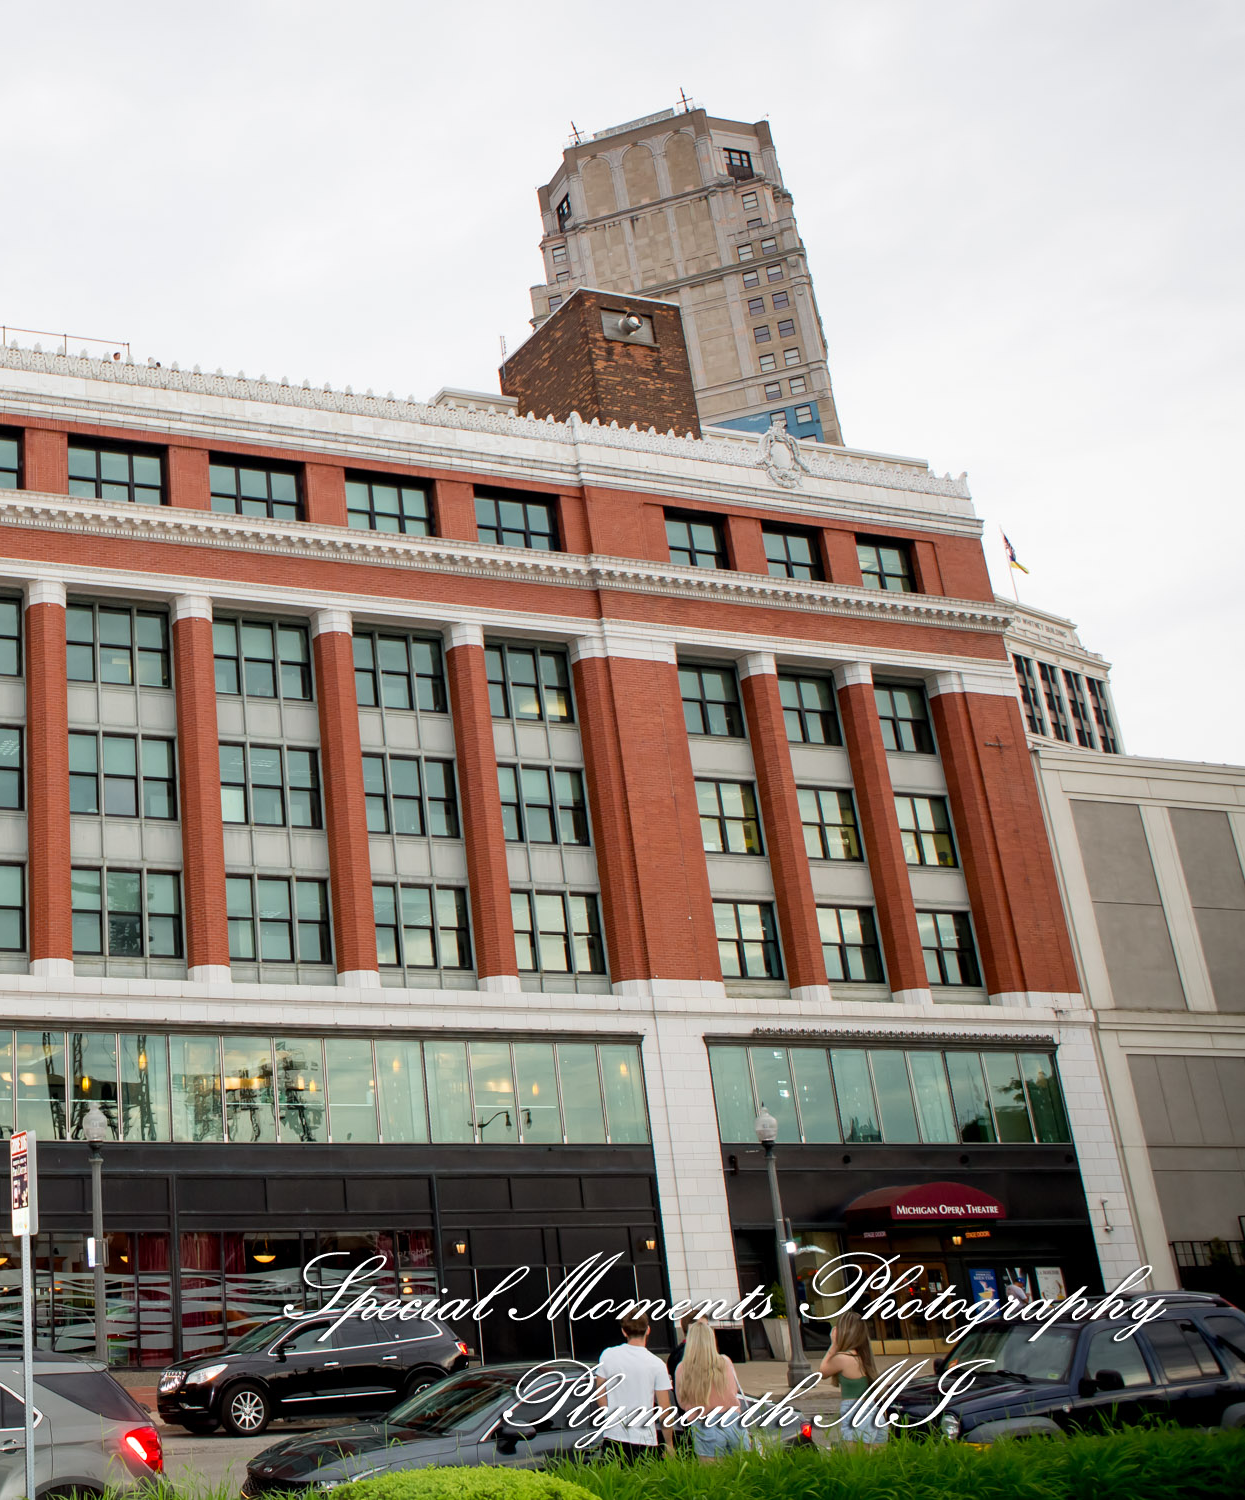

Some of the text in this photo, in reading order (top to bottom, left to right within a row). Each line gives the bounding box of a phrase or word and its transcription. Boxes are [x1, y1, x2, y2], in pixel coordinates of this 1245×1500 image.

[896, 1204, 999, 1216] MICHIGAN OPERA THEATRE
